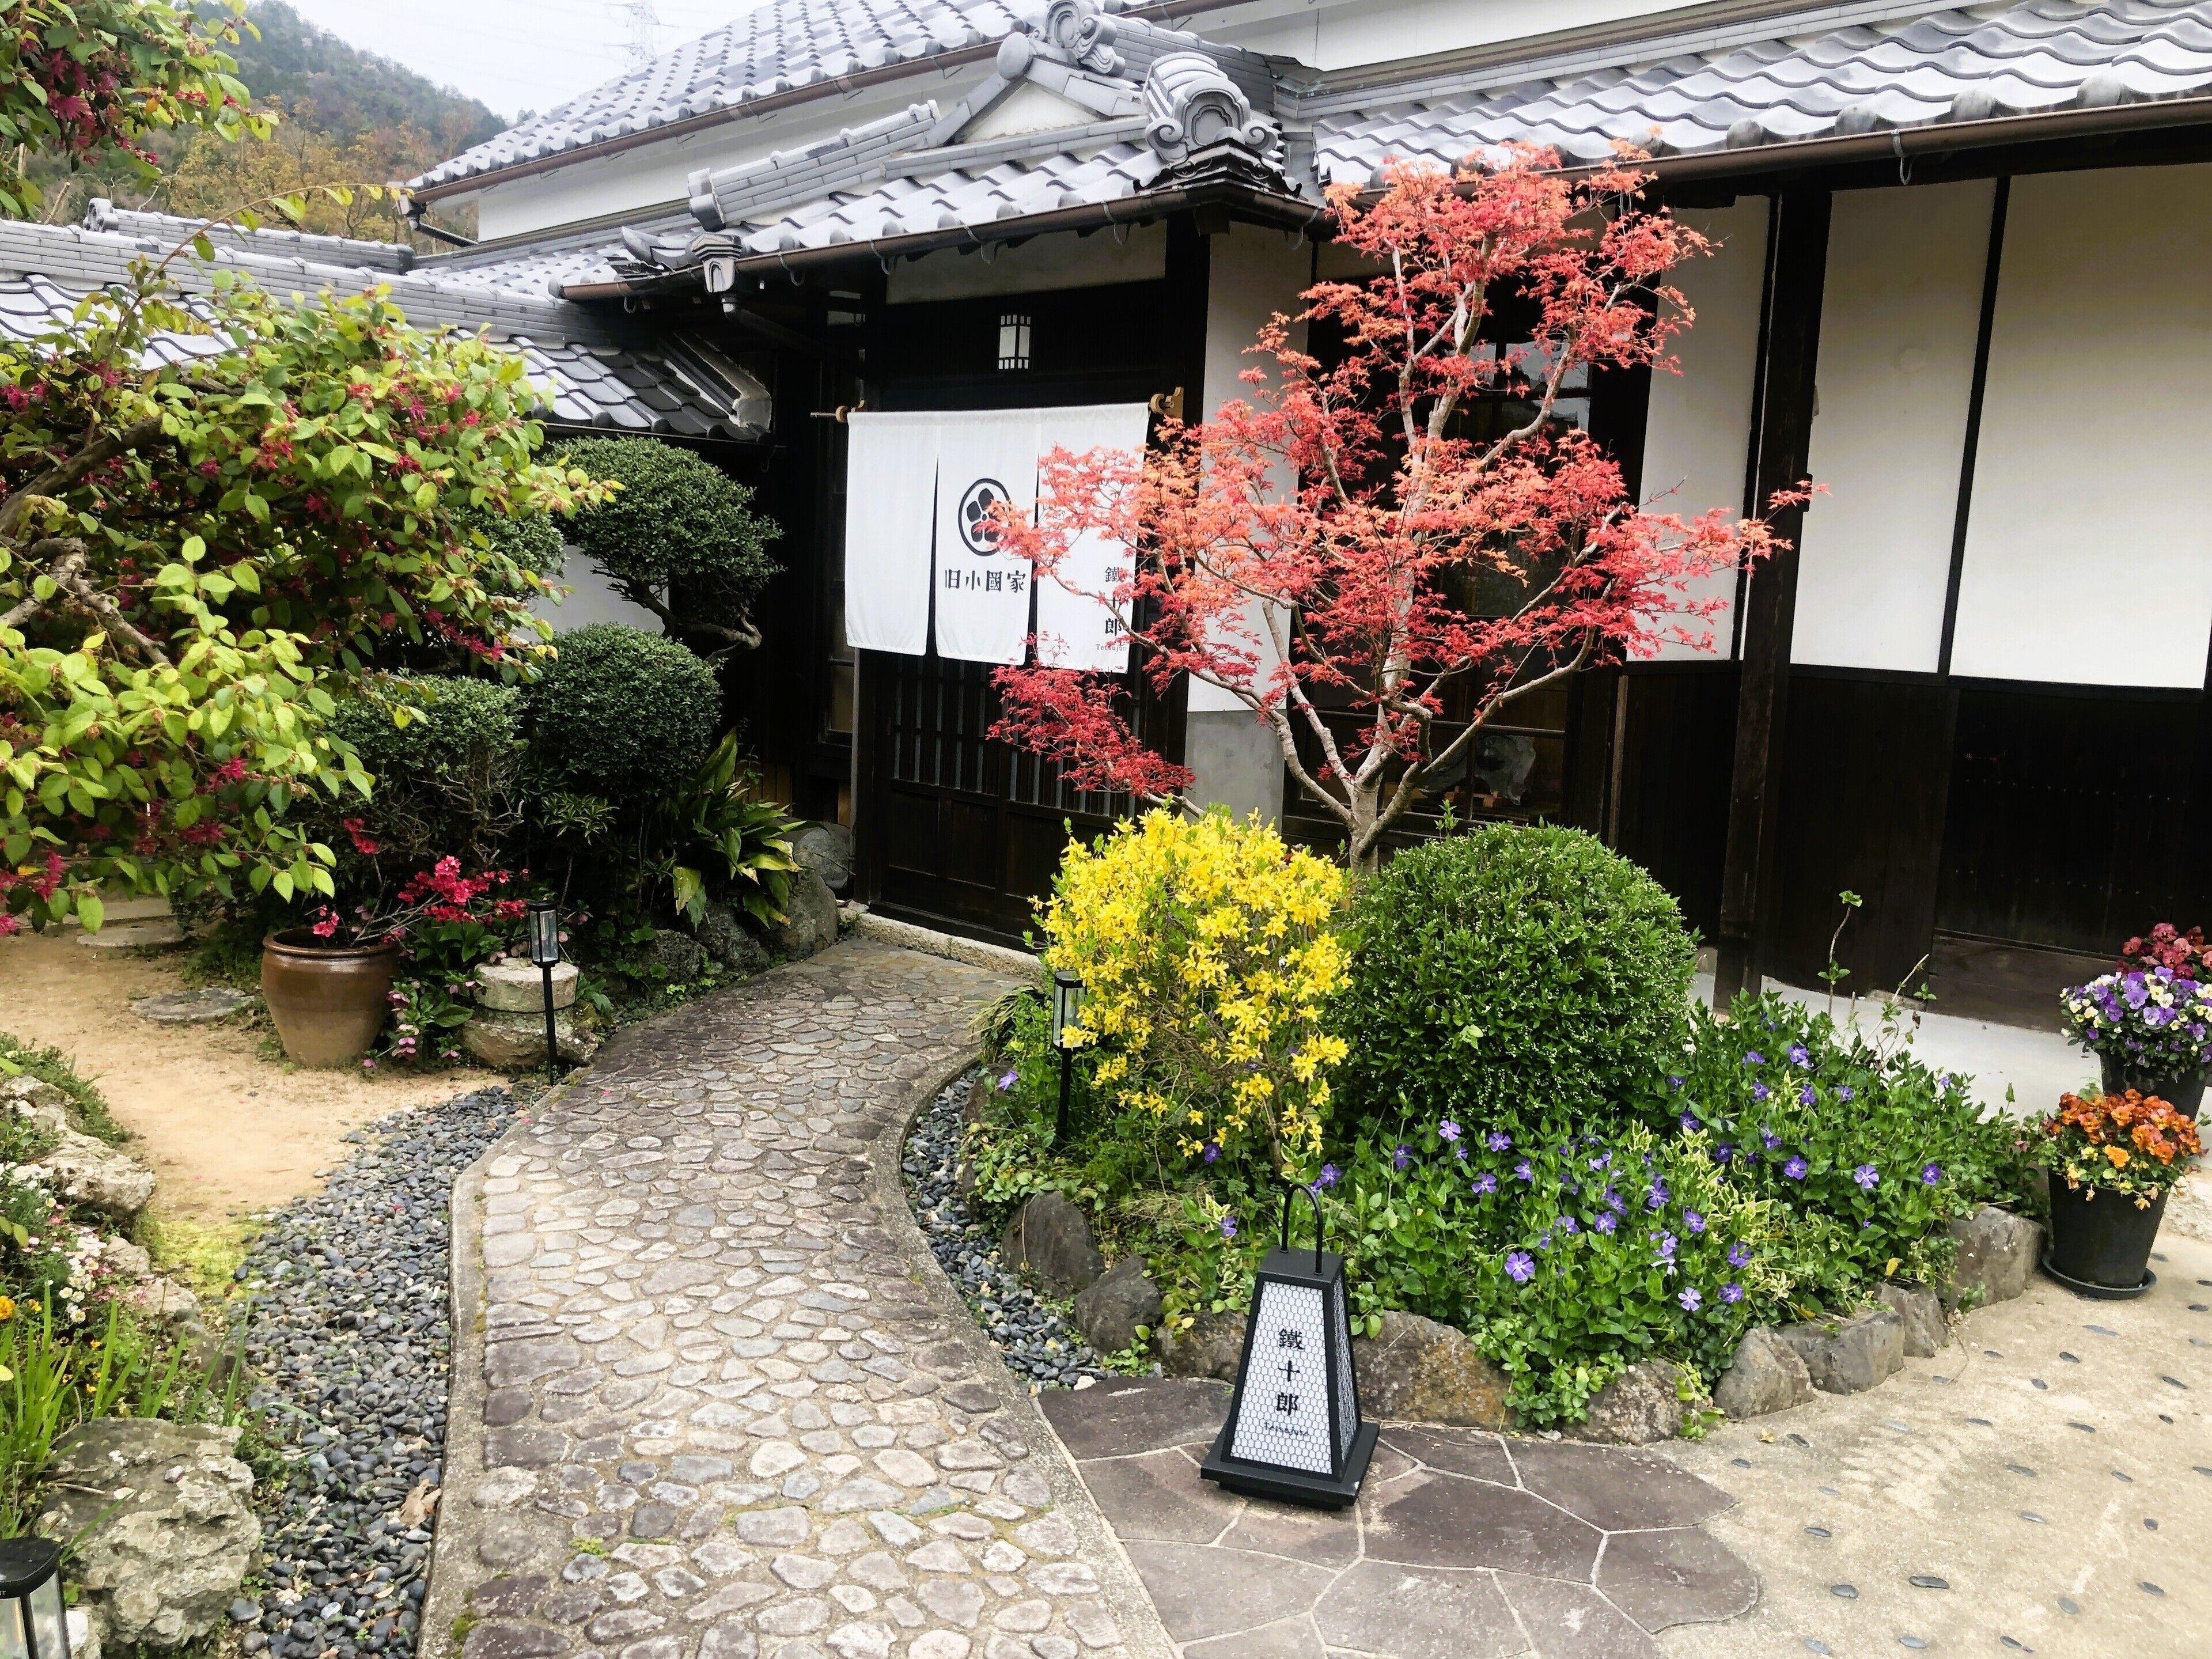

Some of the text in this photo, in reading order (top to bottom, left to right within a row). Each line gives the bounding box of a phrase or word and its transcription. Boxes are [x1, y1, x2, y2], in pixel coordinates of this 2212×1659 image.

[945, 569, 1026, 593] 旧小國家
[1276, 1328, 1305, 1416] 鐵十郎
